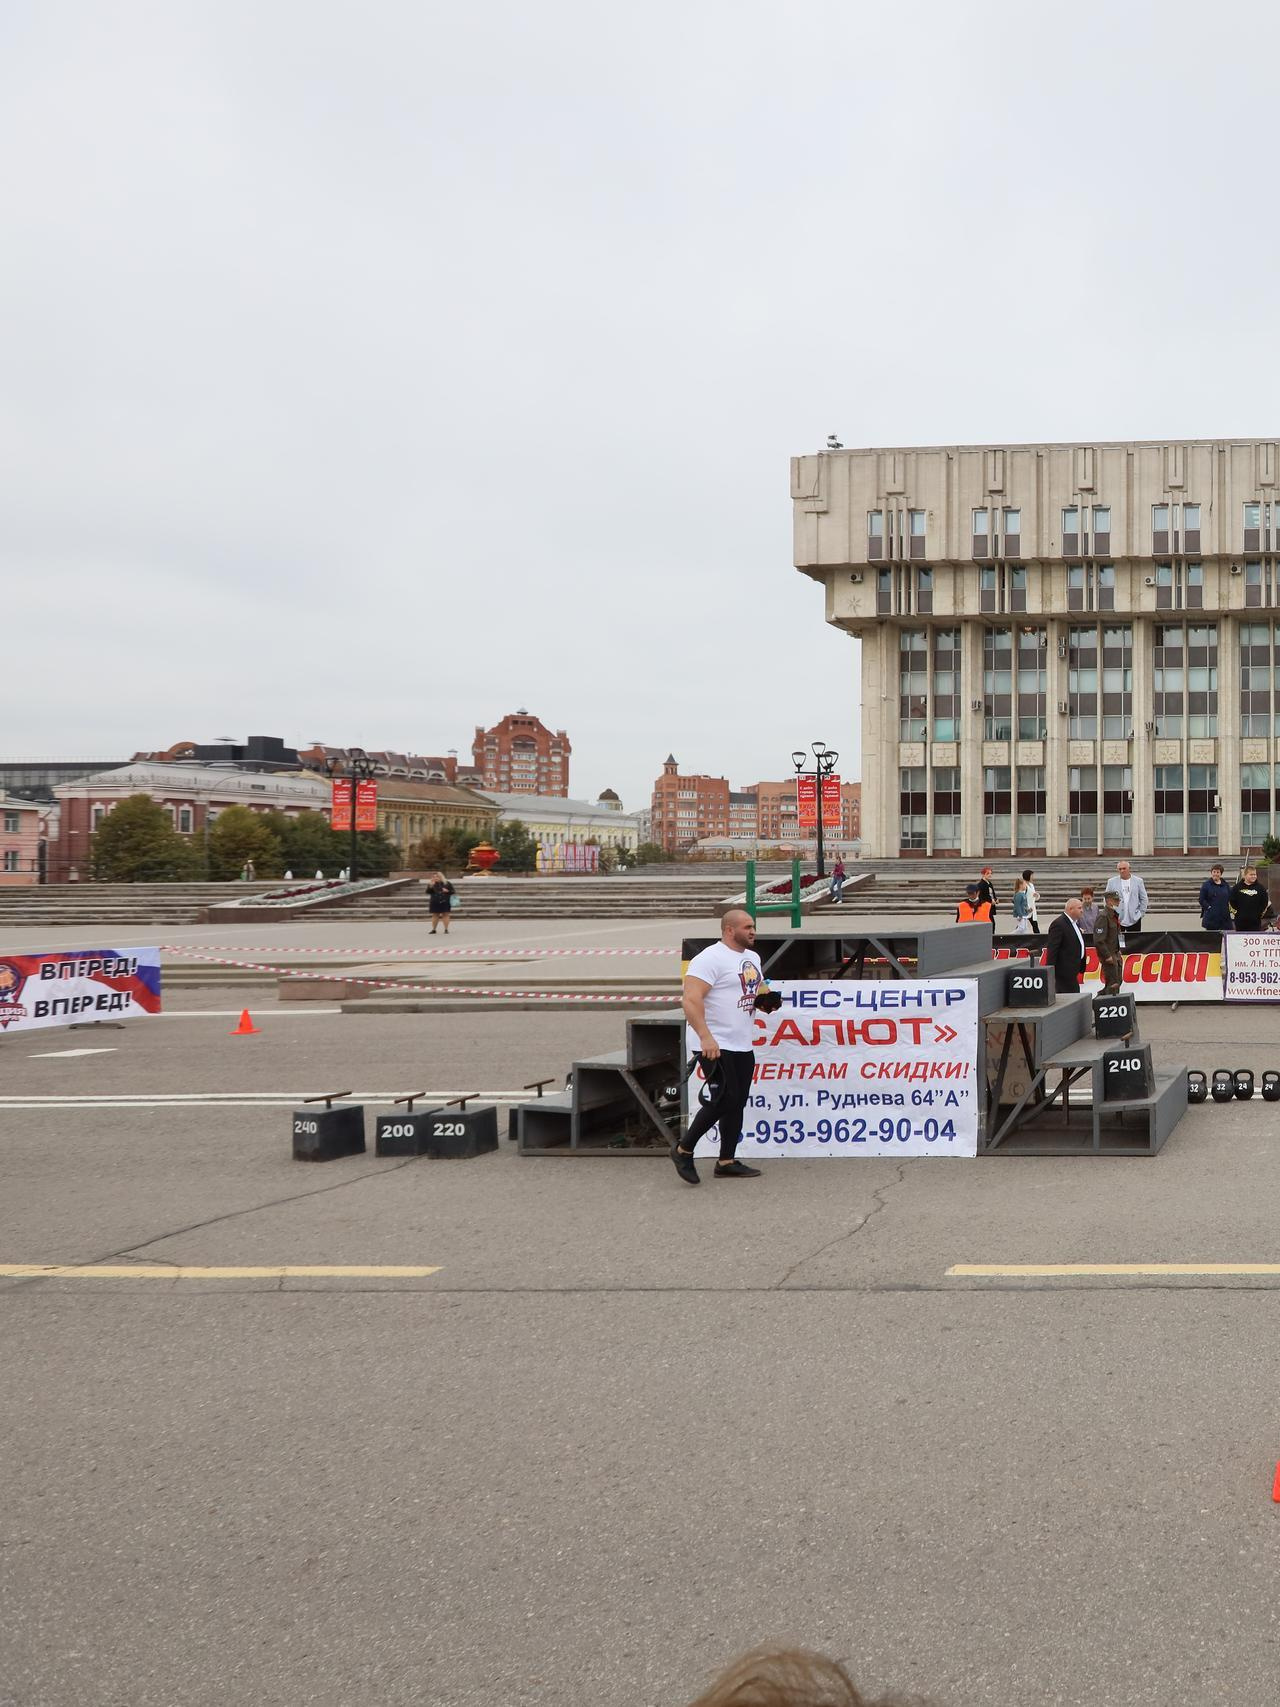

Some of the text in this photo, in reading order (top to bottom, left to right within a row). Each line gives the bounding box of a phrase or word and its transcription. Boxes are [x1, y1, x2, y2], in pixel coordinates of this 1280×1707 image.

[1243, 937, 1261, 948] 300
[40, 957, 138, 981] ВПЕРЕД!
[1078, 946, 1210, 985] Рссии
[1012, 976, 1044, 990] 200
[34, 991, 132, 1018] ВПЕРЕД!
[1099, 1005, 1128, 1018] 220
[860, 1061, 970, 1083] СКИДКИ!
[1108, 1058, 1142, 1073] 240
[1216, 1083, 1226, 1091] 32
[778, 1094, 809, 1111] ул.
[817, 1090, 905, 1110] Руднева
[294, 1120, 317, 1134] 240
[381, 1124, 415, 1138] 200
[433, 1123, 466, 1137] 220
